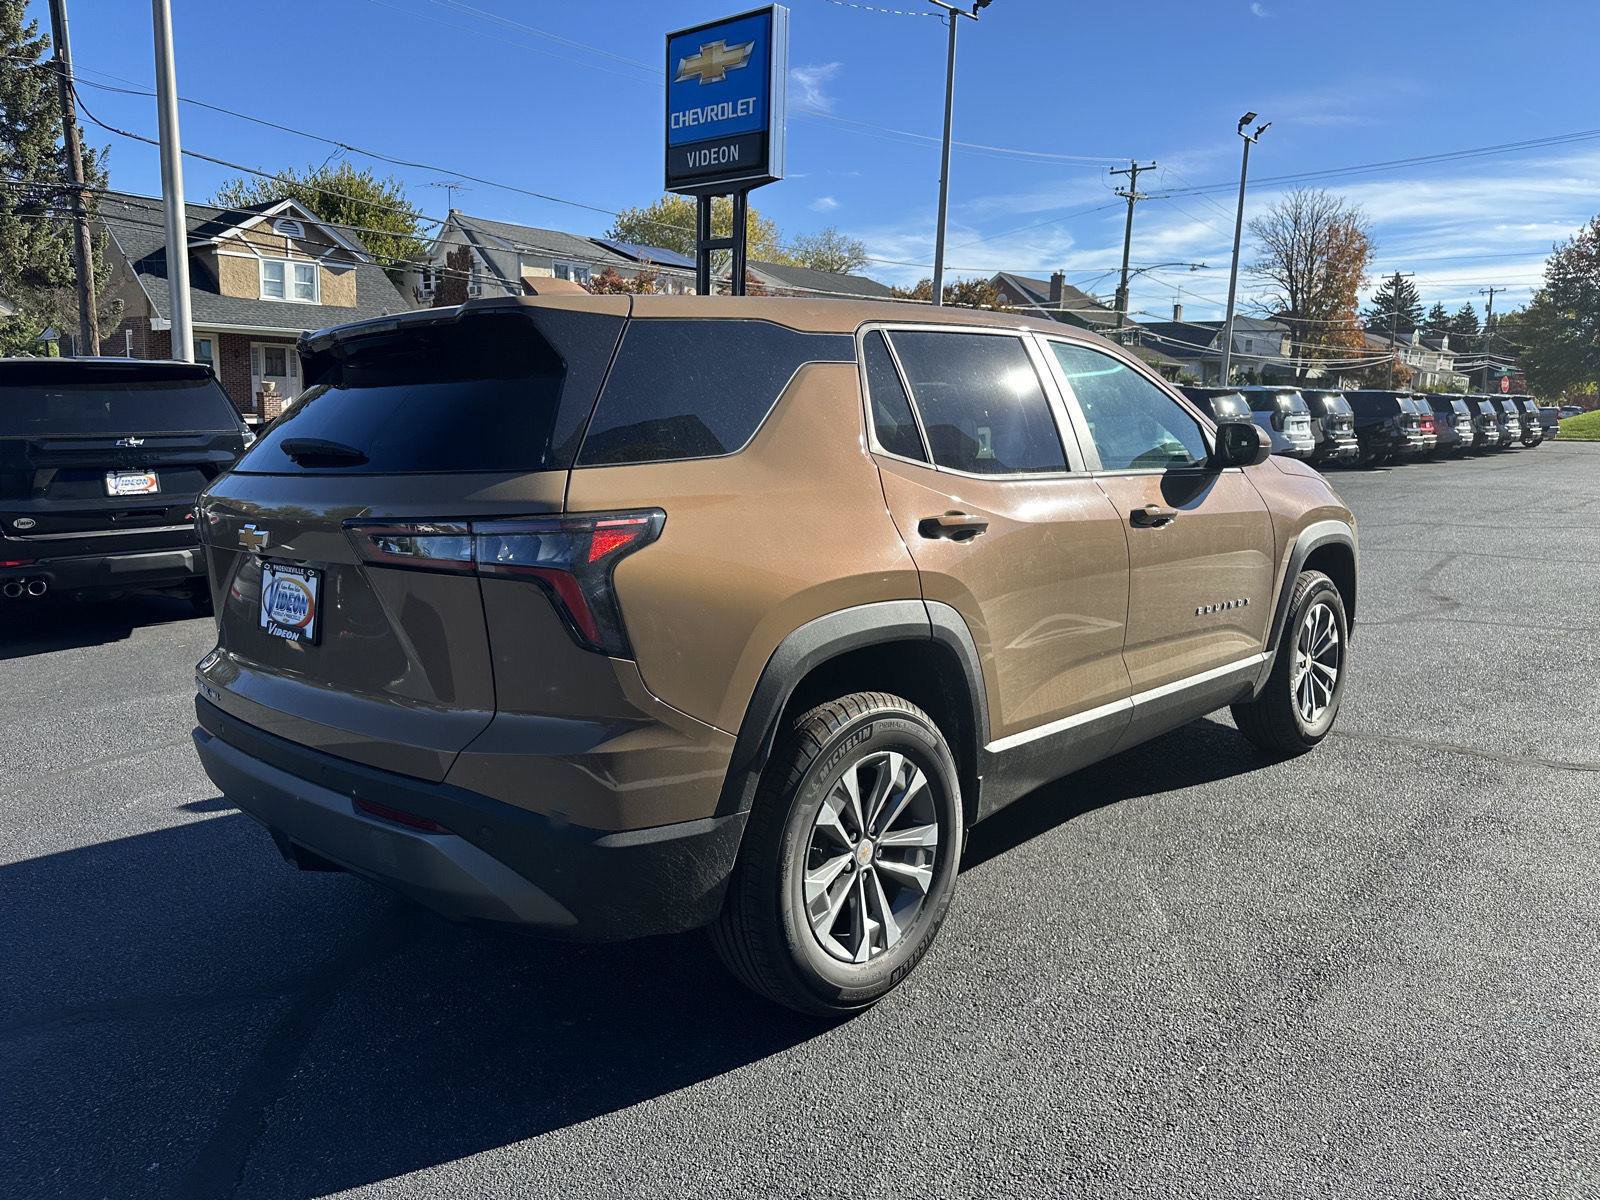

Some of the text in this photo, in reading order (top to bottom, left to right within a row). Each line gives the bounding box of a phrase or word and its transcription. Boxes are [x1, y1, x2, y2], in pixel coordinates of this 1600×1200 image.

[671, 97, 756, 129] CHEVROLET
[687, 144, 739, 167] VIDEON
[1195, 597, 1250, 616] EQUINOX
[268, 622, 300, 641] VIDEON
[819, 726, 872, 780] MICHELIN
